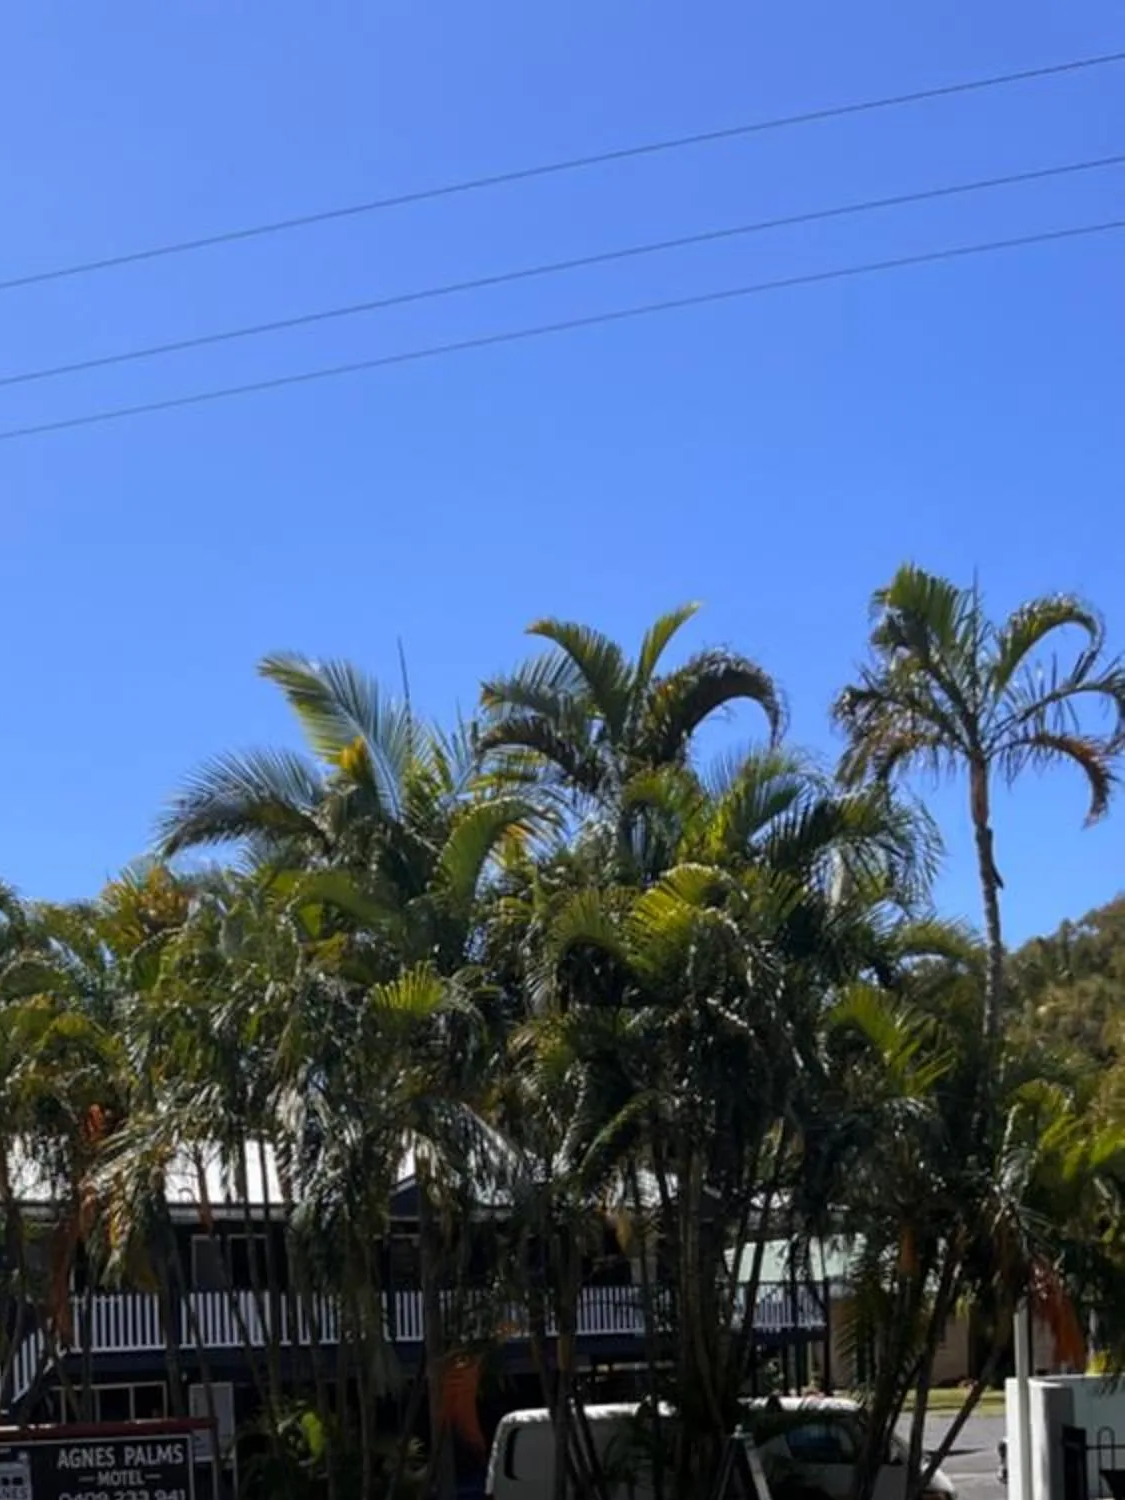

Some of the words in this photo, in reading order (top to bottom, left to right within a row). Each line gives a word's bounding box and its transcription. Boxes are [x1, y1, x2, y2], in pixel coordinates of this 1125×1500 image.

[57, 1447, 116, 1469] AGNES
[124, 1444, 184, 1465] PALMS
[97, 1471, 145, 1487] MOTEL
